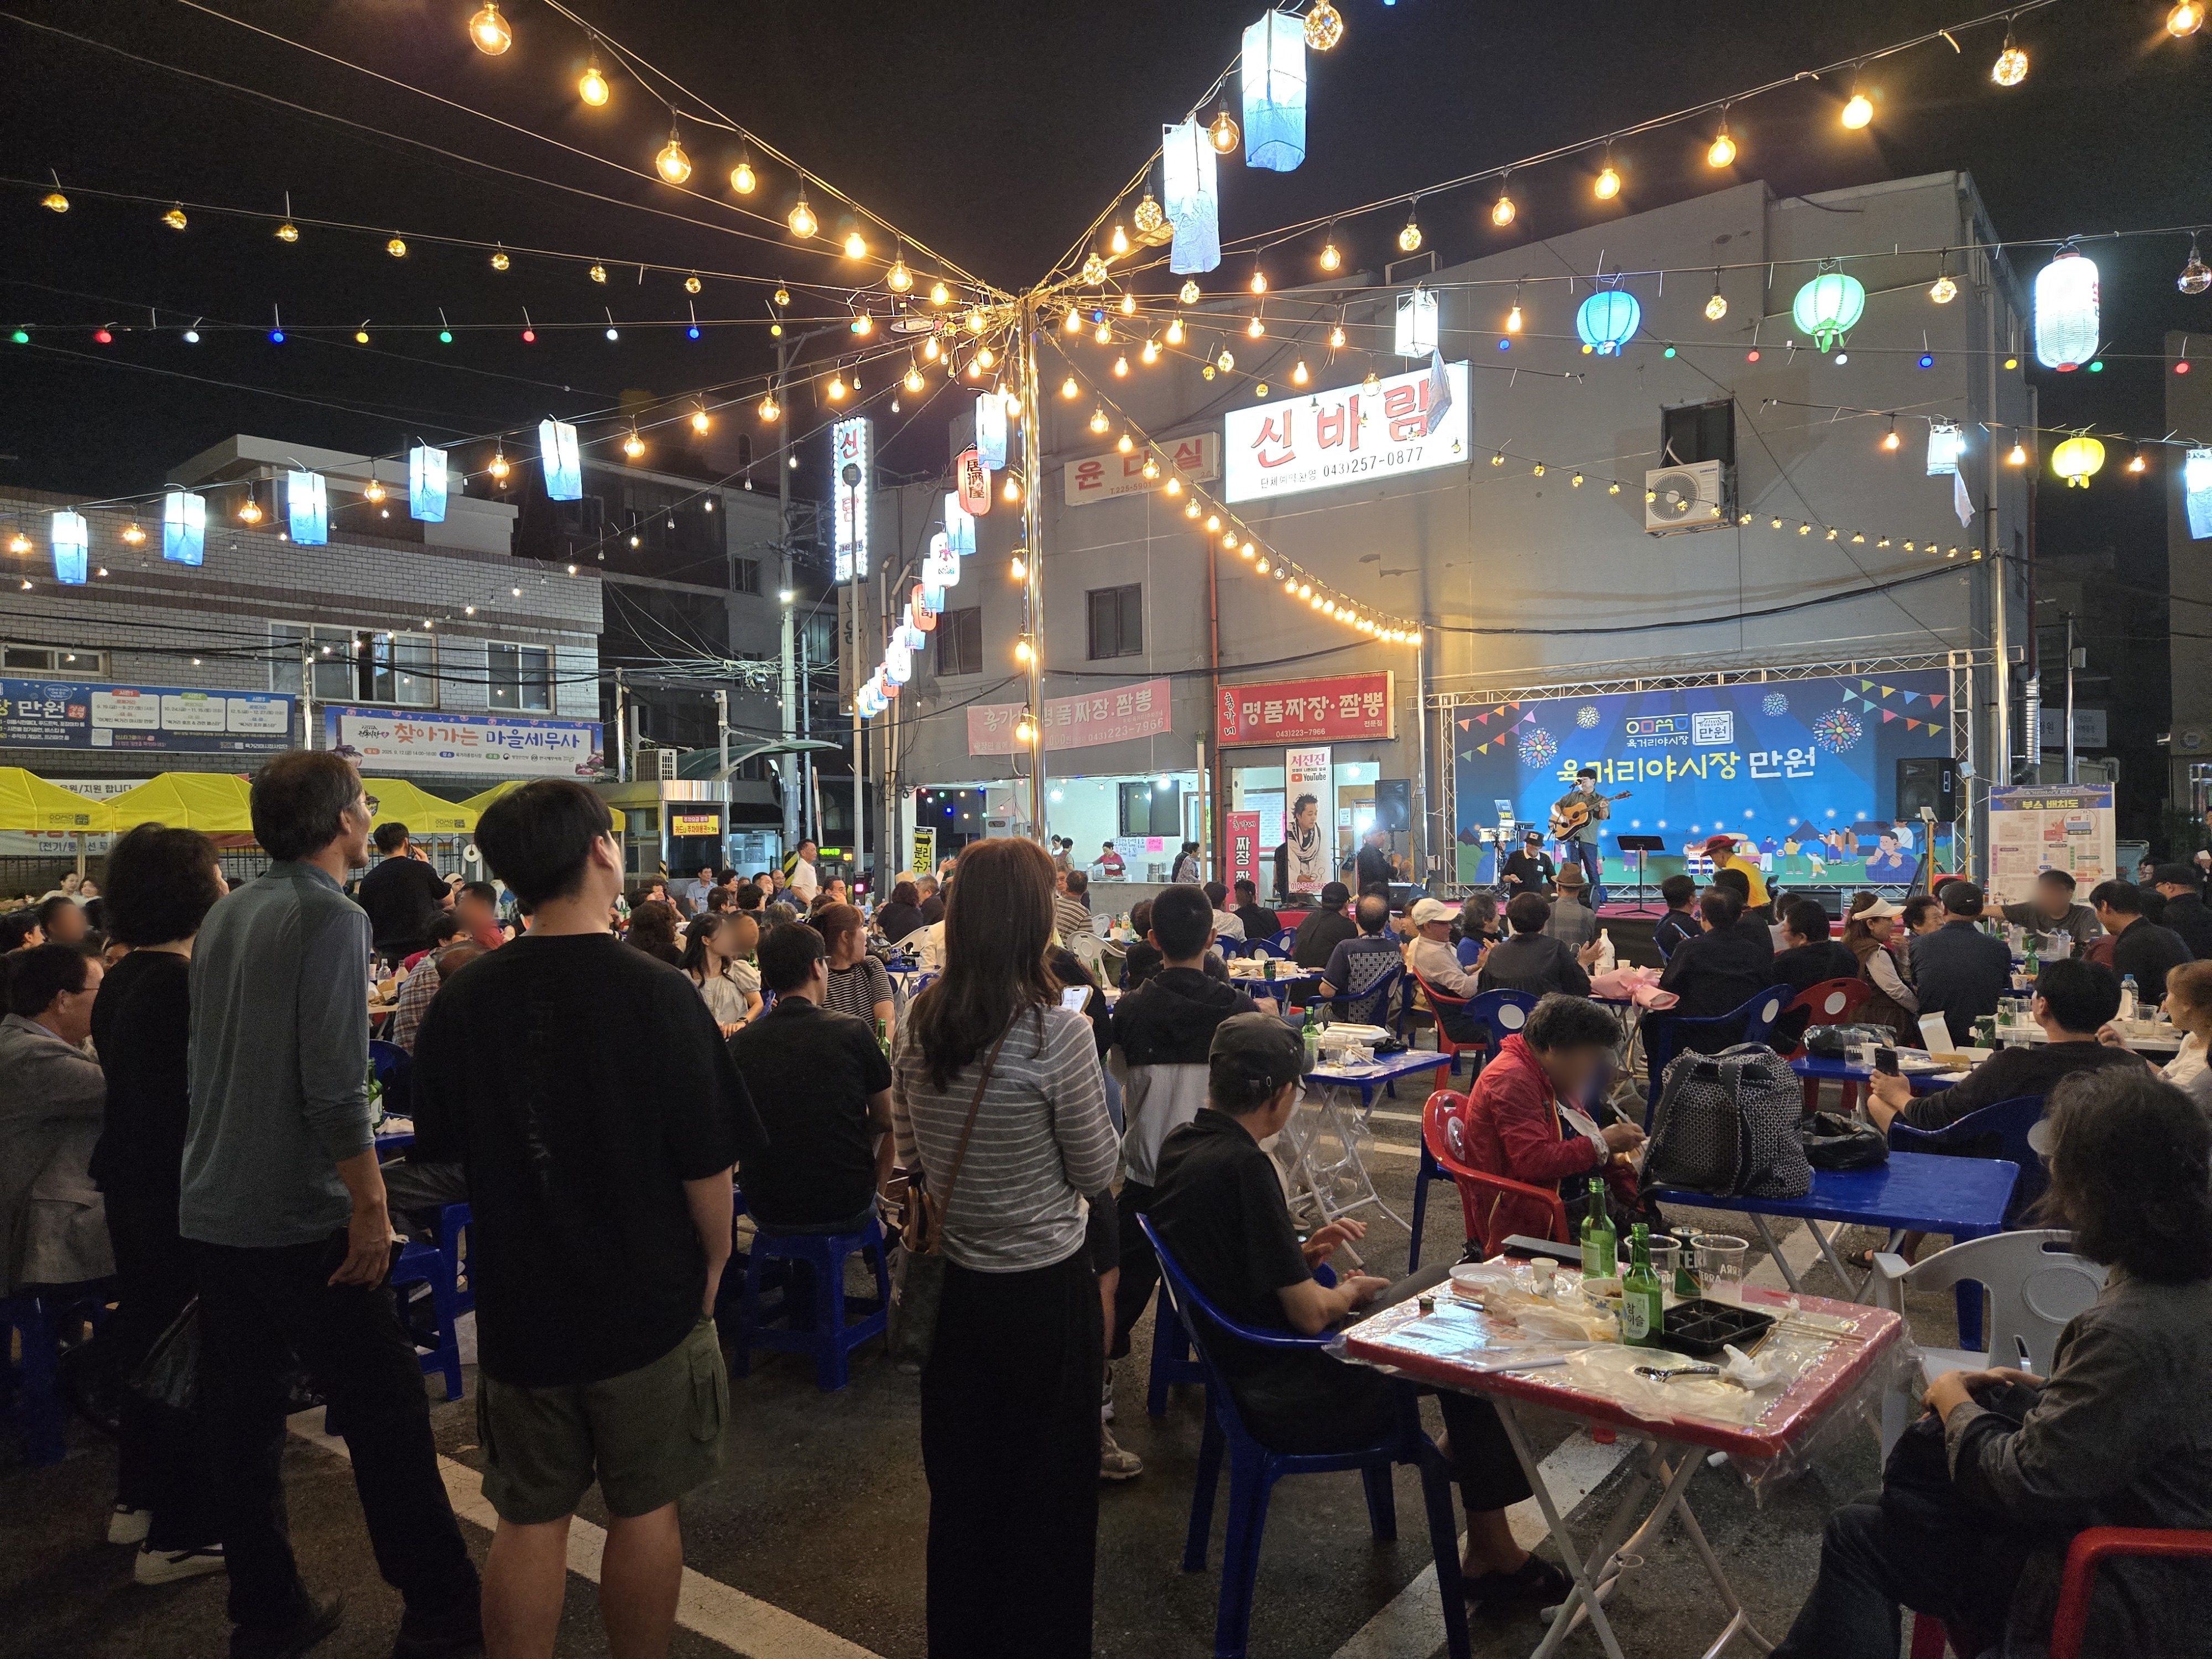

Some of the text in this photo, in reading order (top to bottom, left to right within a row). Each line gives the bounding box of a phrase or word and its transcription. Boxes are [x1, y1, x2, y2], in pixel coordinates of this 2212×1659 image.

[1251, 378, 1430, 468] 신바람
[1323, 446, 1423, 477] 043)257-0877
[1110, 481, 1152, 495] T.225-5901
[18, 701, 65, 718] 만원
[1224, 692, 1237, 736] 홍가네
[1088, 717, 1164, 742] 043)223-7966
[1363, 719, 1383, 728] 전문점
[394, 722, 580, 750] 찾아가는 마을세무사
[1276, 727, 1326, 738] 043)223-7966
[1699, 726, 1726, 739] 만원
[1626, 735, 1689, 749] 육거리야시장
[1290, 753, 1325, 767] 서진진
[1556, 746, 1815, 784] 육거리야시장 만원
[1303, 772, 1327, 781] YouTube
[105, 784, 132, 793] 합니다
[2022, 799, 2079, 809] 부스 배치도
[1233, 820, 1256, 831] 홍가네
[914, 846, 932, 860] 분리
[1235, 836, 1251, 865] 짜장
[913, 860, 932, 874] 수거
[1626, 1302, 1636, 1314] 참
[1627, 1314, 1645, 1327] 이슬
